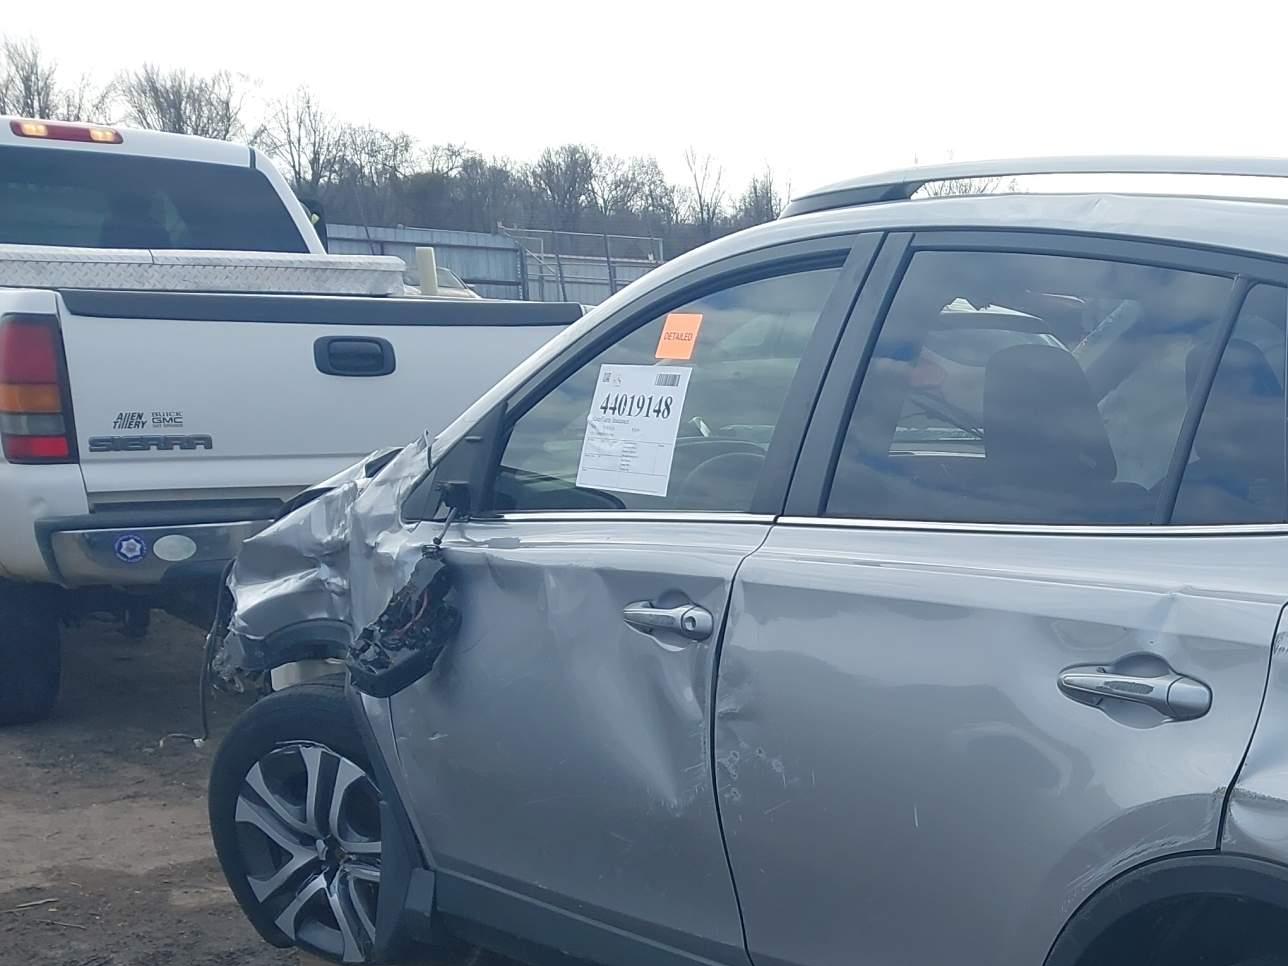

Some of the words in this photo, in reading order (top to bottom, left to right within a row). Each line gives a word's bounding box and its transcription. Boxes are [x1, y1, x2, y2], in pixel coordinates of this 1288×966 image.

[663, 331, 693, 342] DETAILED
[599, 391, 673, 420] 44019148
[152, 416, 184, 424] GMC
[88, 434, 213, 453] SIERRA
